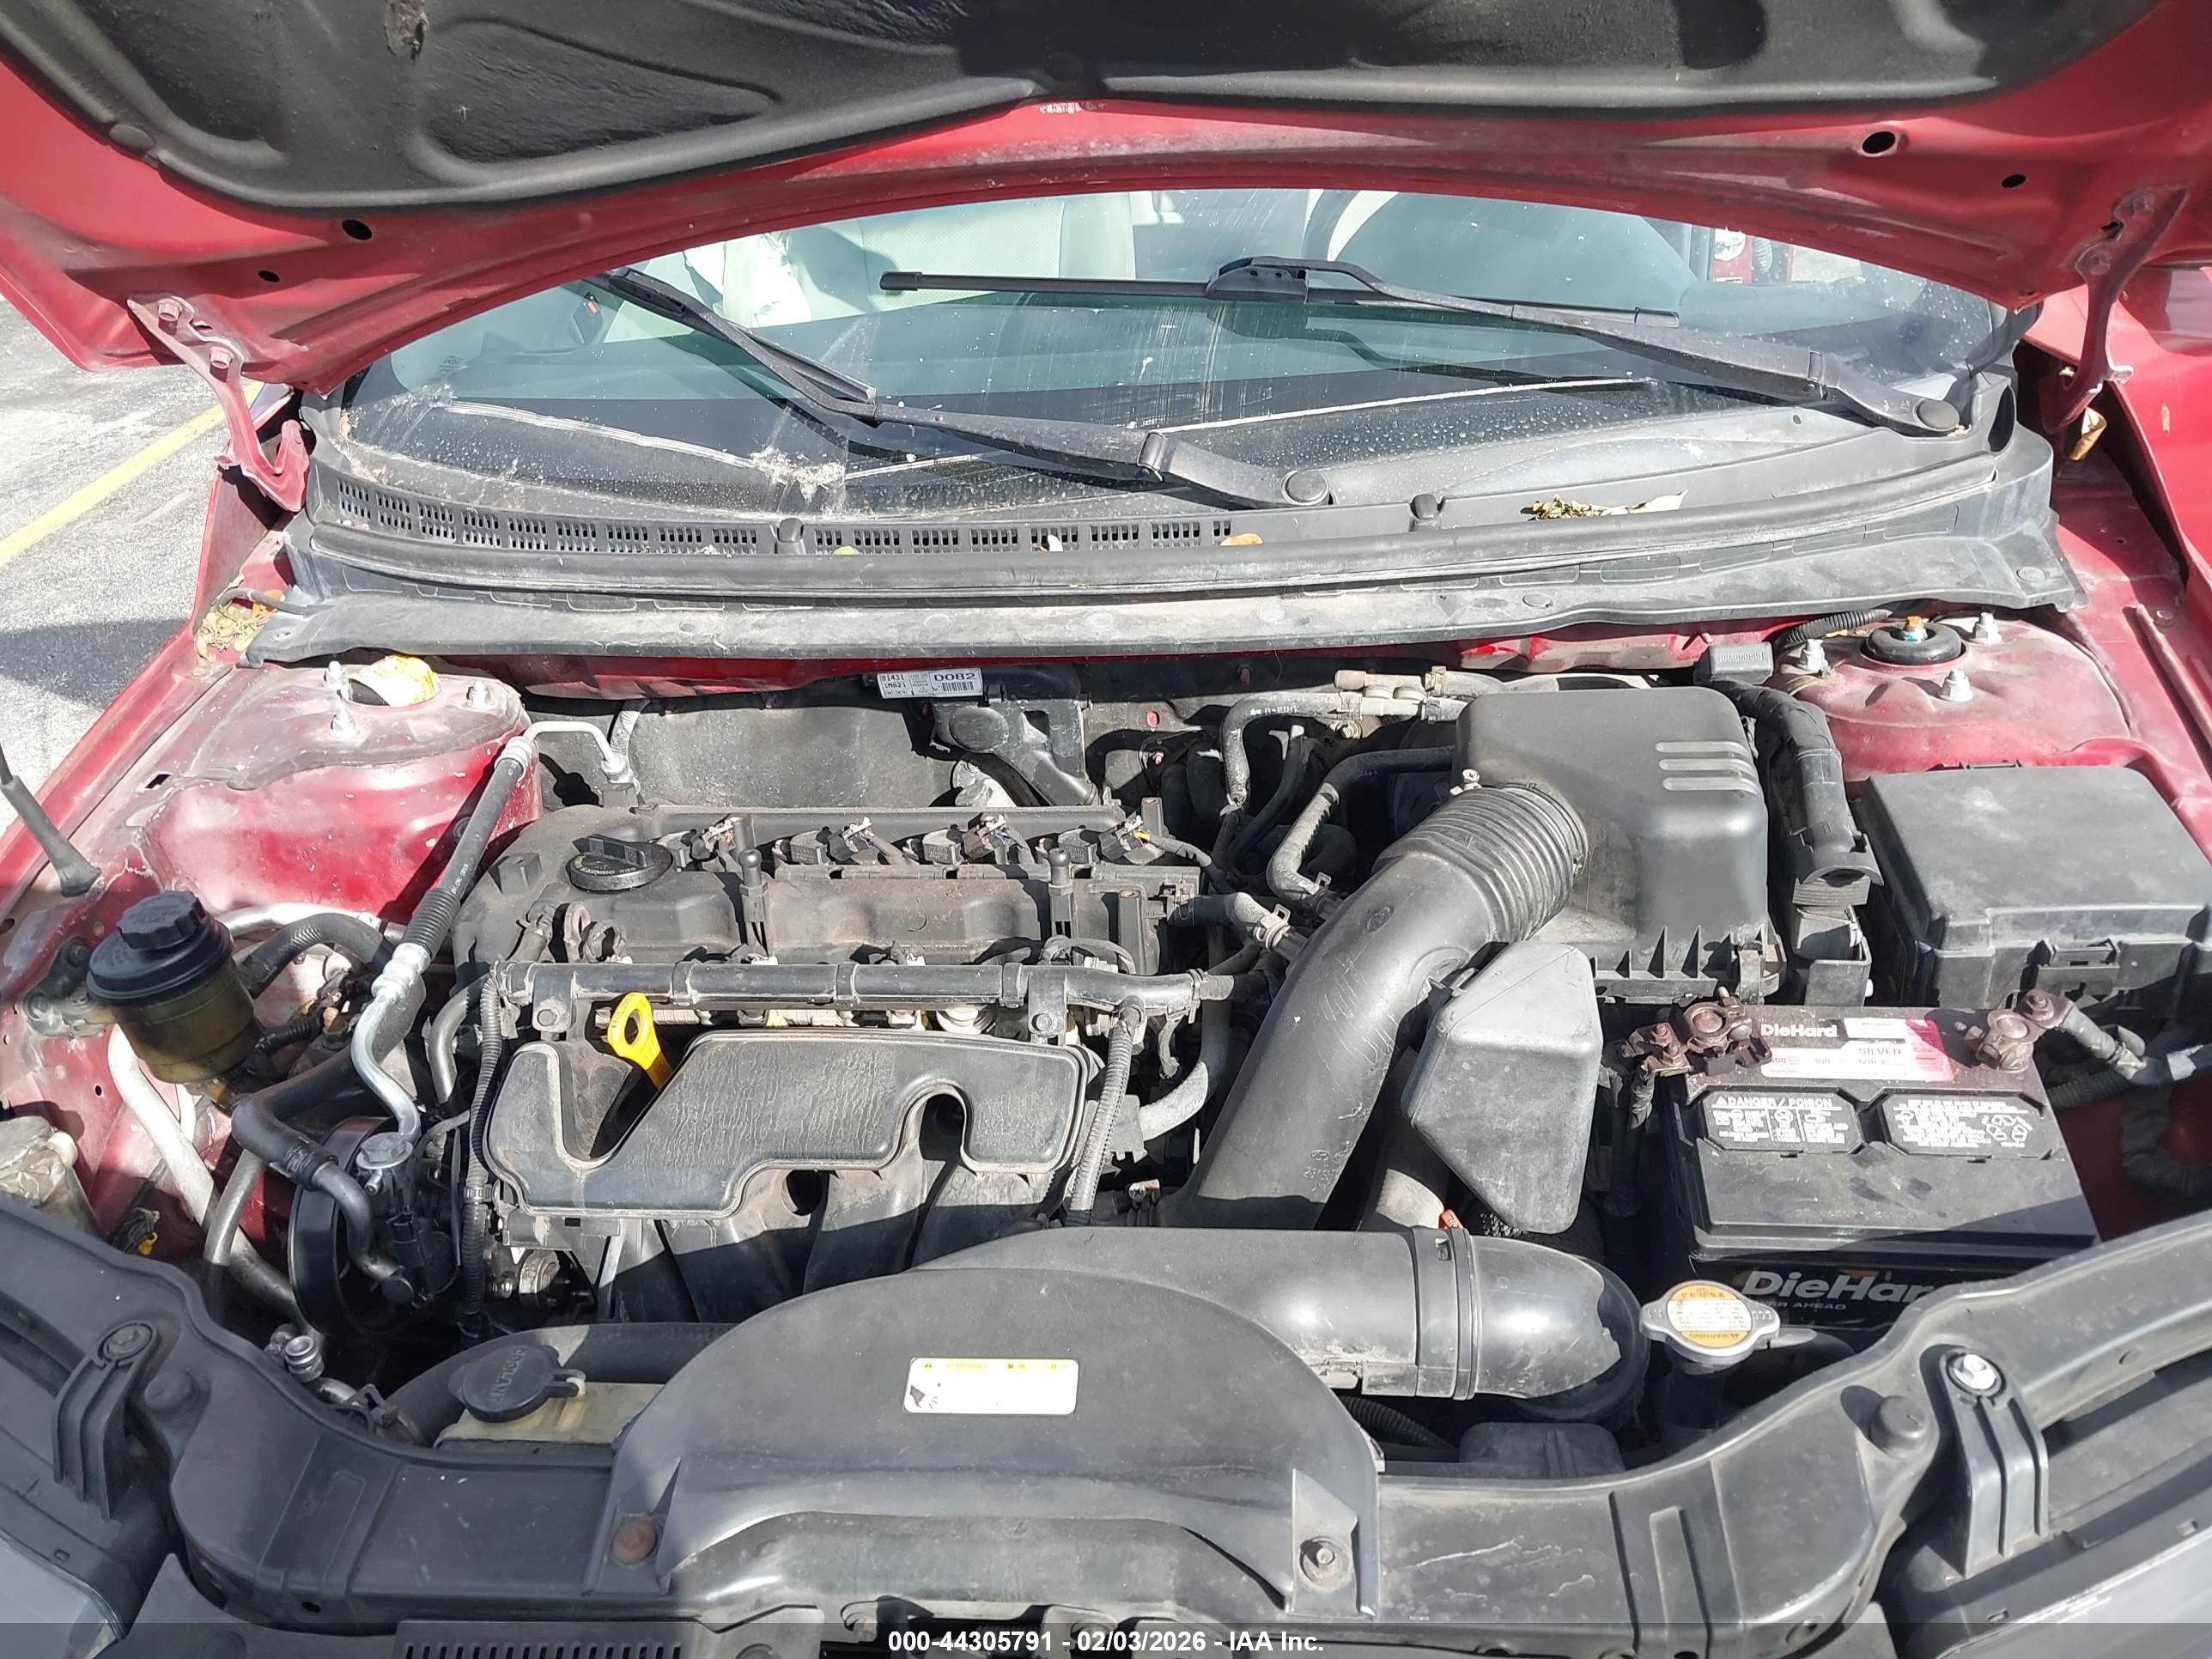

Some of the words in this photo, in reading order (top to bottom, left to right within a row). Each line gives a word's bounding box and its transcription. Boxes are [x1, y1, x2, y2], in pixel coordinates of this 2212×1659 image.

[933, 672, 975, 681] D082
[1760, 1023, 1838, 1037] DieHard
[1858, 1047, 1902, 1055] SILVER
[1728, 1097, 1778, 1107] DANGER
[1788, 1098, 1832, 1108] POISON
[1741, 1270, 1935, 1303] DieHar
[488, 1346, 530, 1402] COOLANT
